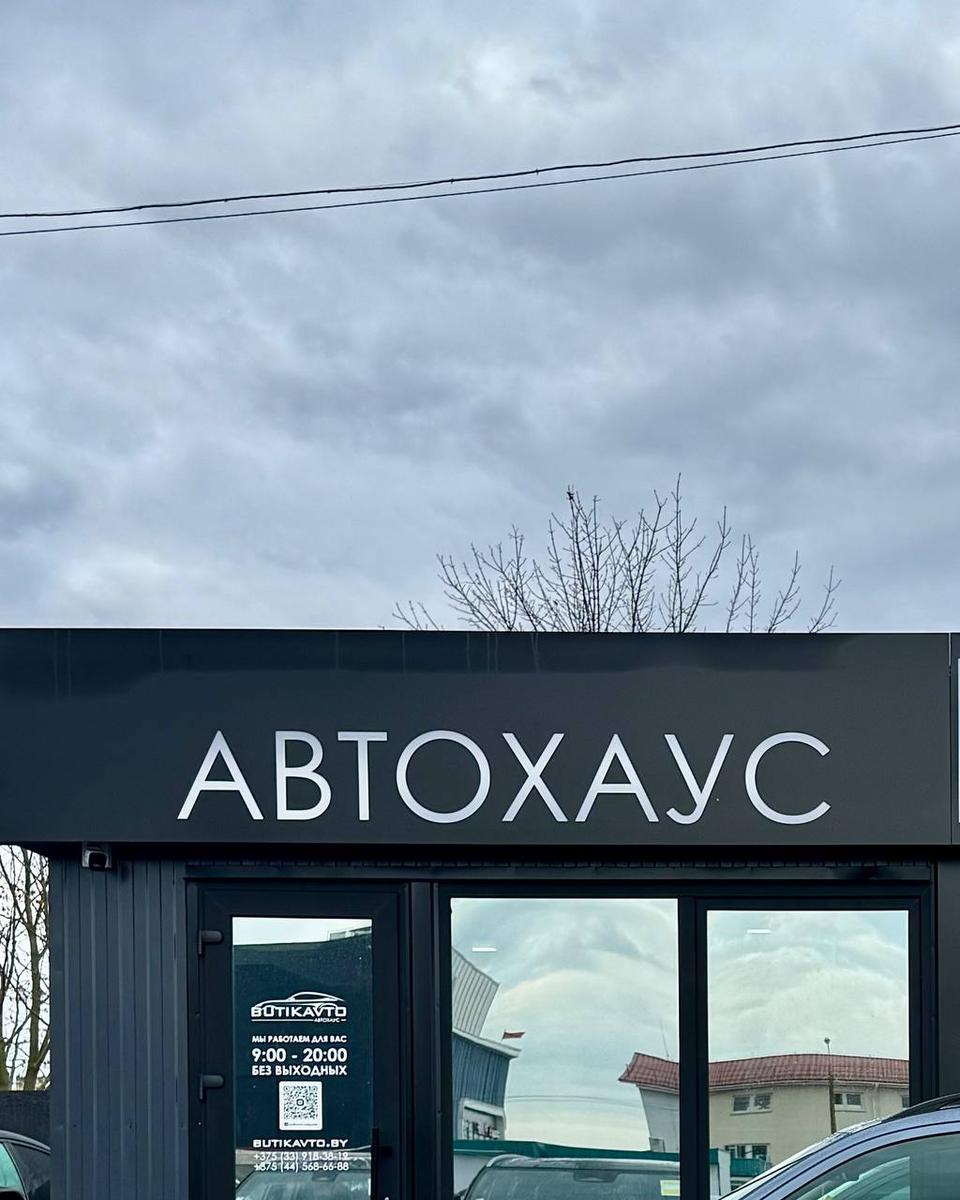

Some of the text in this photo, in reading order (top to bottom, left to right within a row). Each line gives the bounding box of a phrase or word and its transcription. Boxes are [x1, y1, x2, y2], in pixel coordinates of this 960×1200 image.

[177, 729, 832, 825] АВТОХАУС
[251, 1006, 347, 1017] BUTIKAVTO
[252, 1035, 347, 1043] МЫ РАБОТАЕМ ДЛЯ ВАС
[251, 1048, 287, 1062] 9:00
[302, 1048, 348, 1062] 20:00
[252, 1065, 348, 1077] БЕЗ ВЫХОДНЫХ
[253, 1139, 349, 1148] BUTIKAVTO.BY
[253, 1151, 348, 1163] +375 (33) 918-38-19
[253, 1162, 349, 1173] +375 (44) 568-66-88
